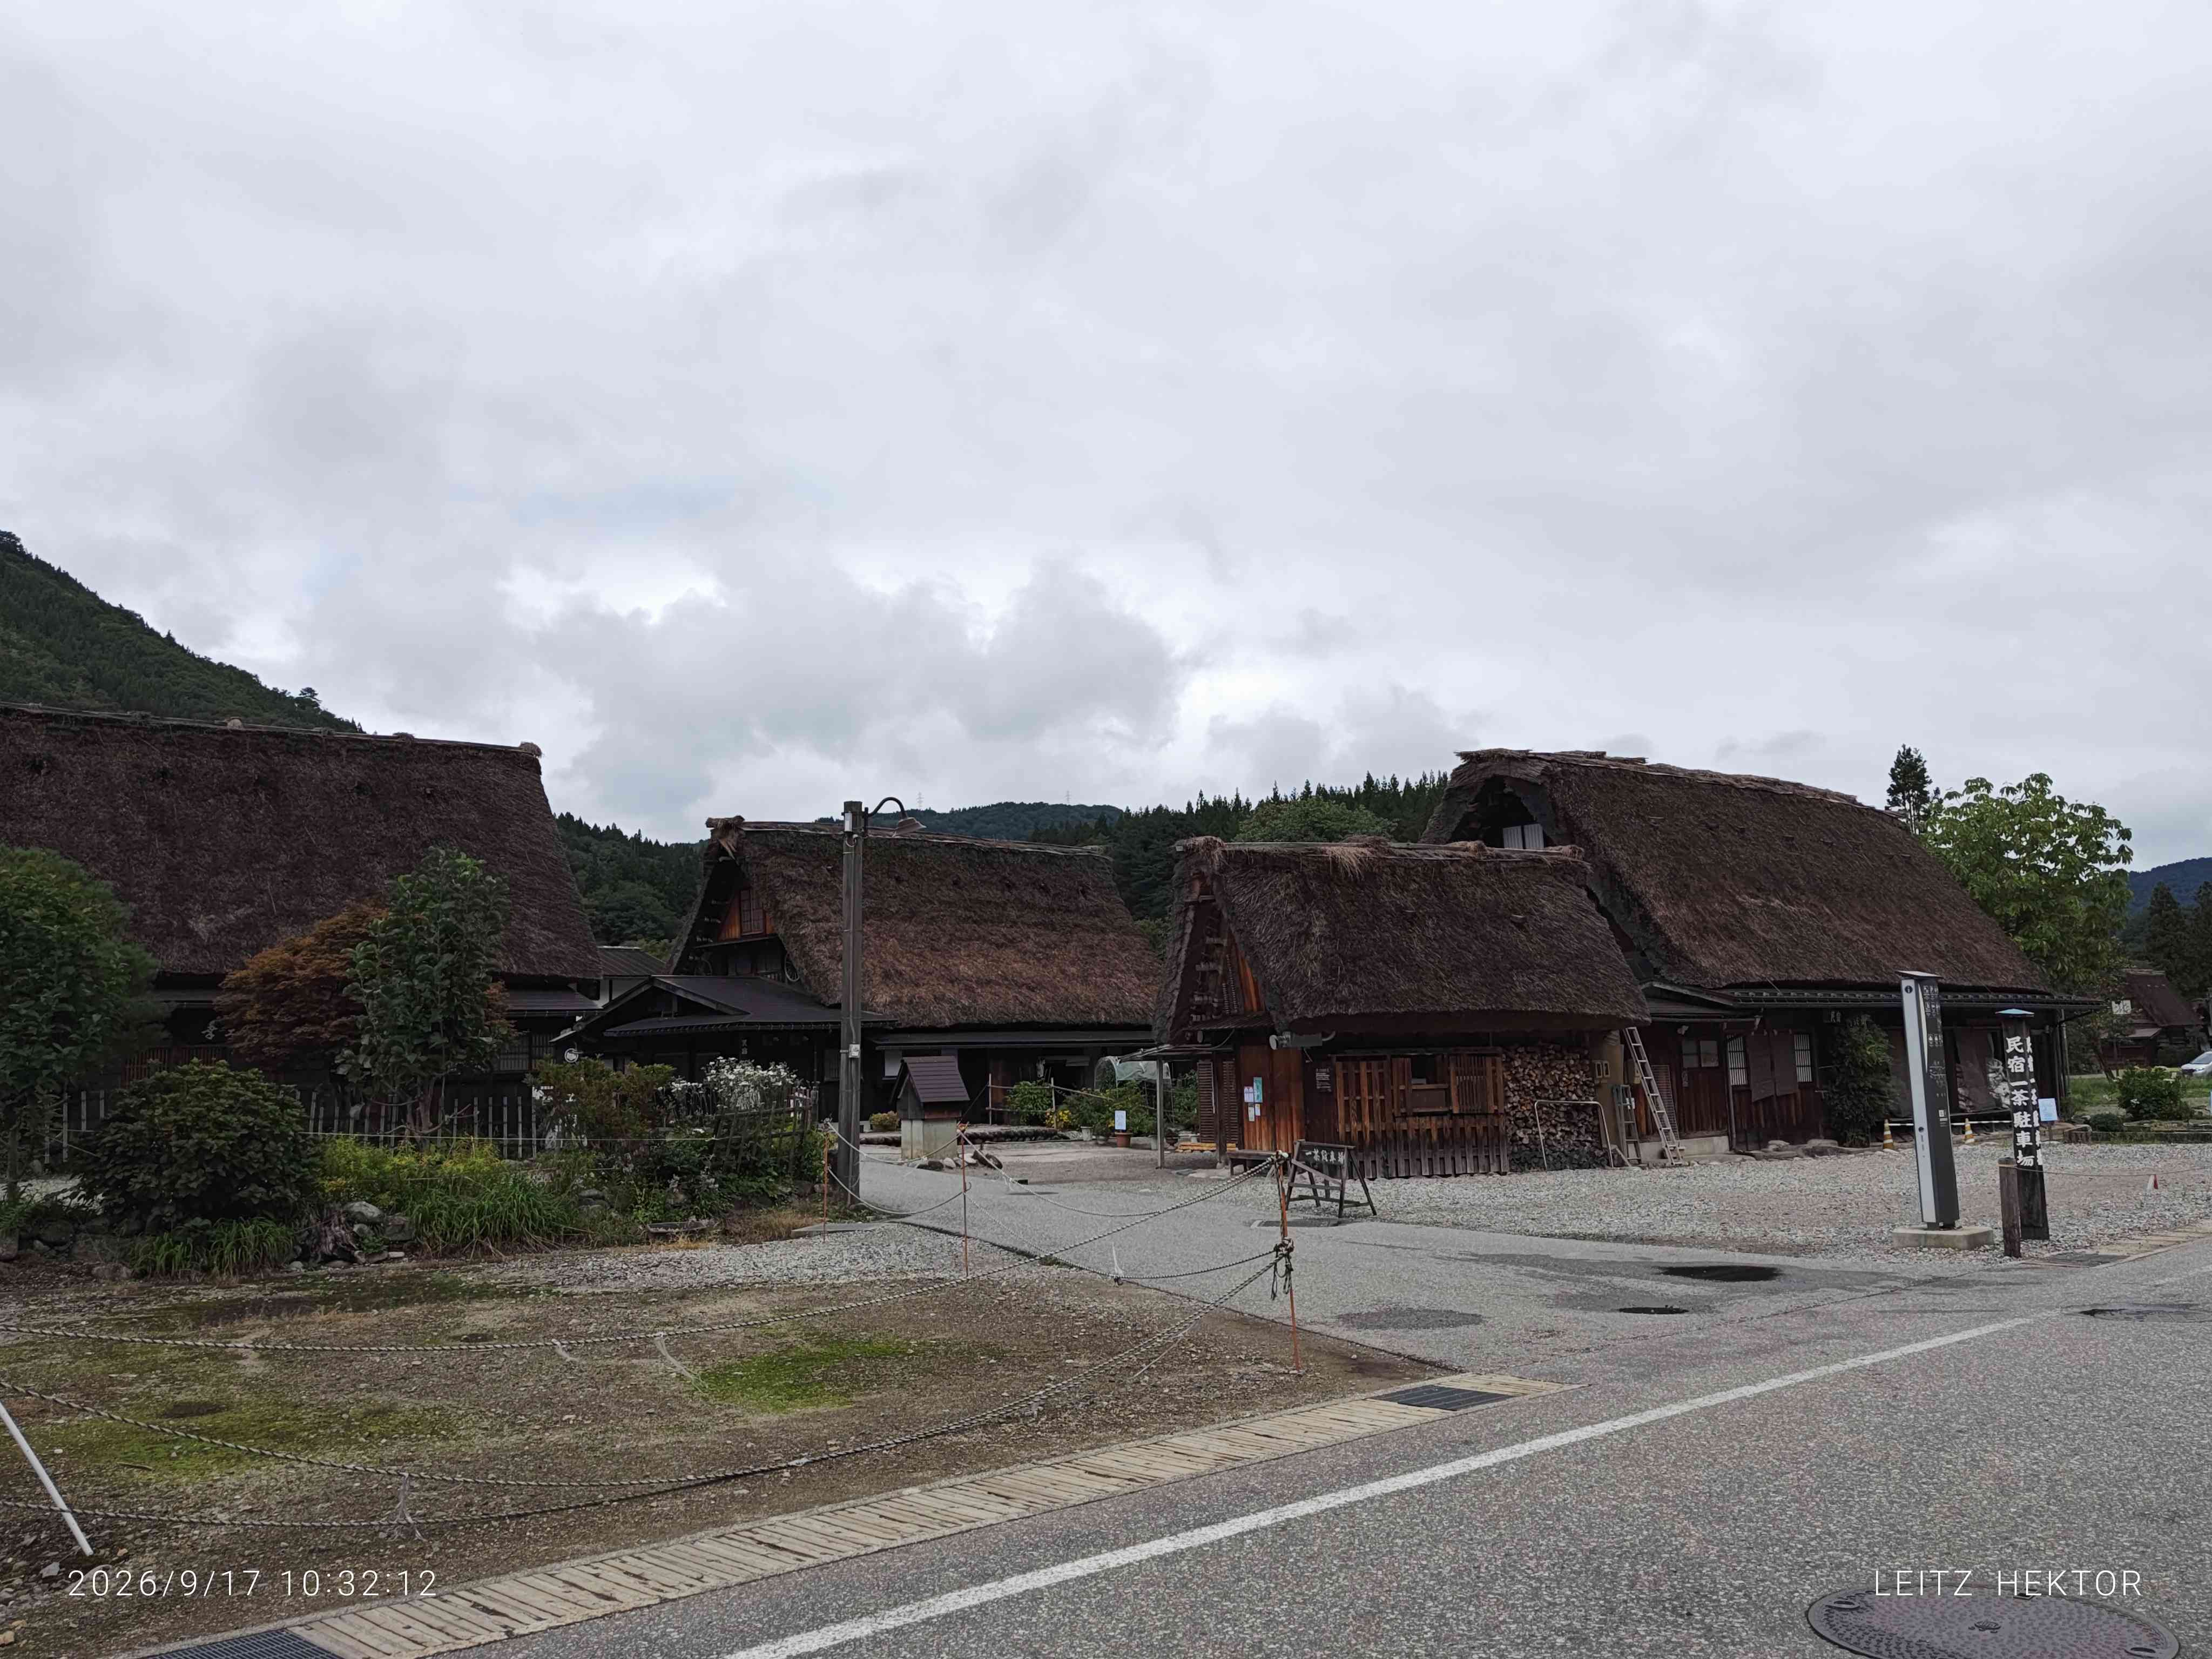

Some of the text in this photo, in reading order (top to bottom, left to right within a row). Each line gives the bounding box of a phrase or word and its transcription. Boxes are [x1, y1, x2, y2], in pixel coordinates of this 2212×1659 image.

[2006, 1036, 2035, 1167] 民宿一茶駐車場
